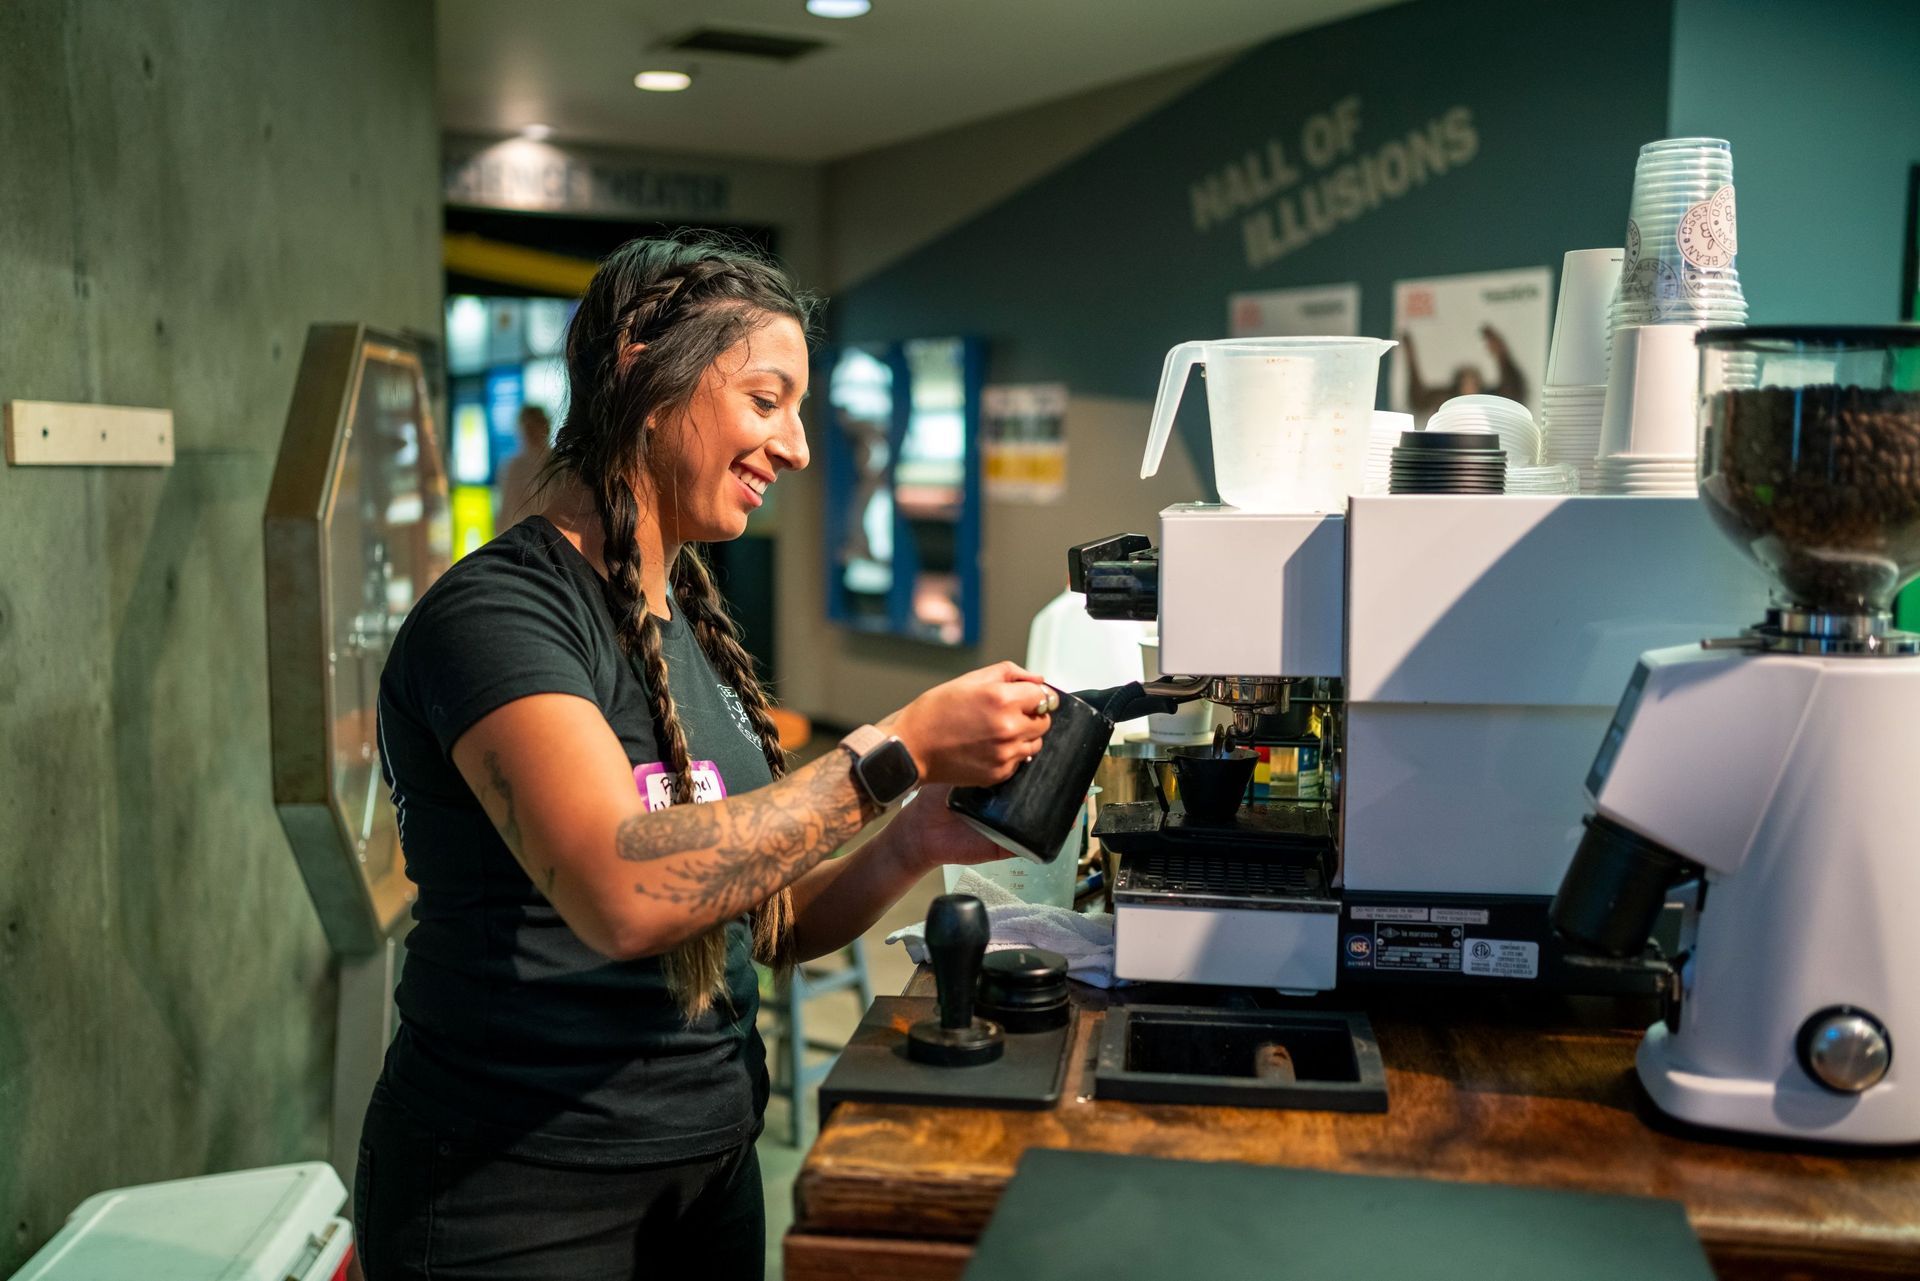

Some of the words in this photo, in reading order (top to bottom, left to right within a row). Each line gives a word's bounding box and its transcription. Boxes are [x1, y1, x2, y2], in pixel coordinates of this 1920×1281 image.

[1191, 139, 1298, 231] HALL
[1302, 96, 1360, 168] OF
[1244, 107, 1478, 269] ILLUSIONS
